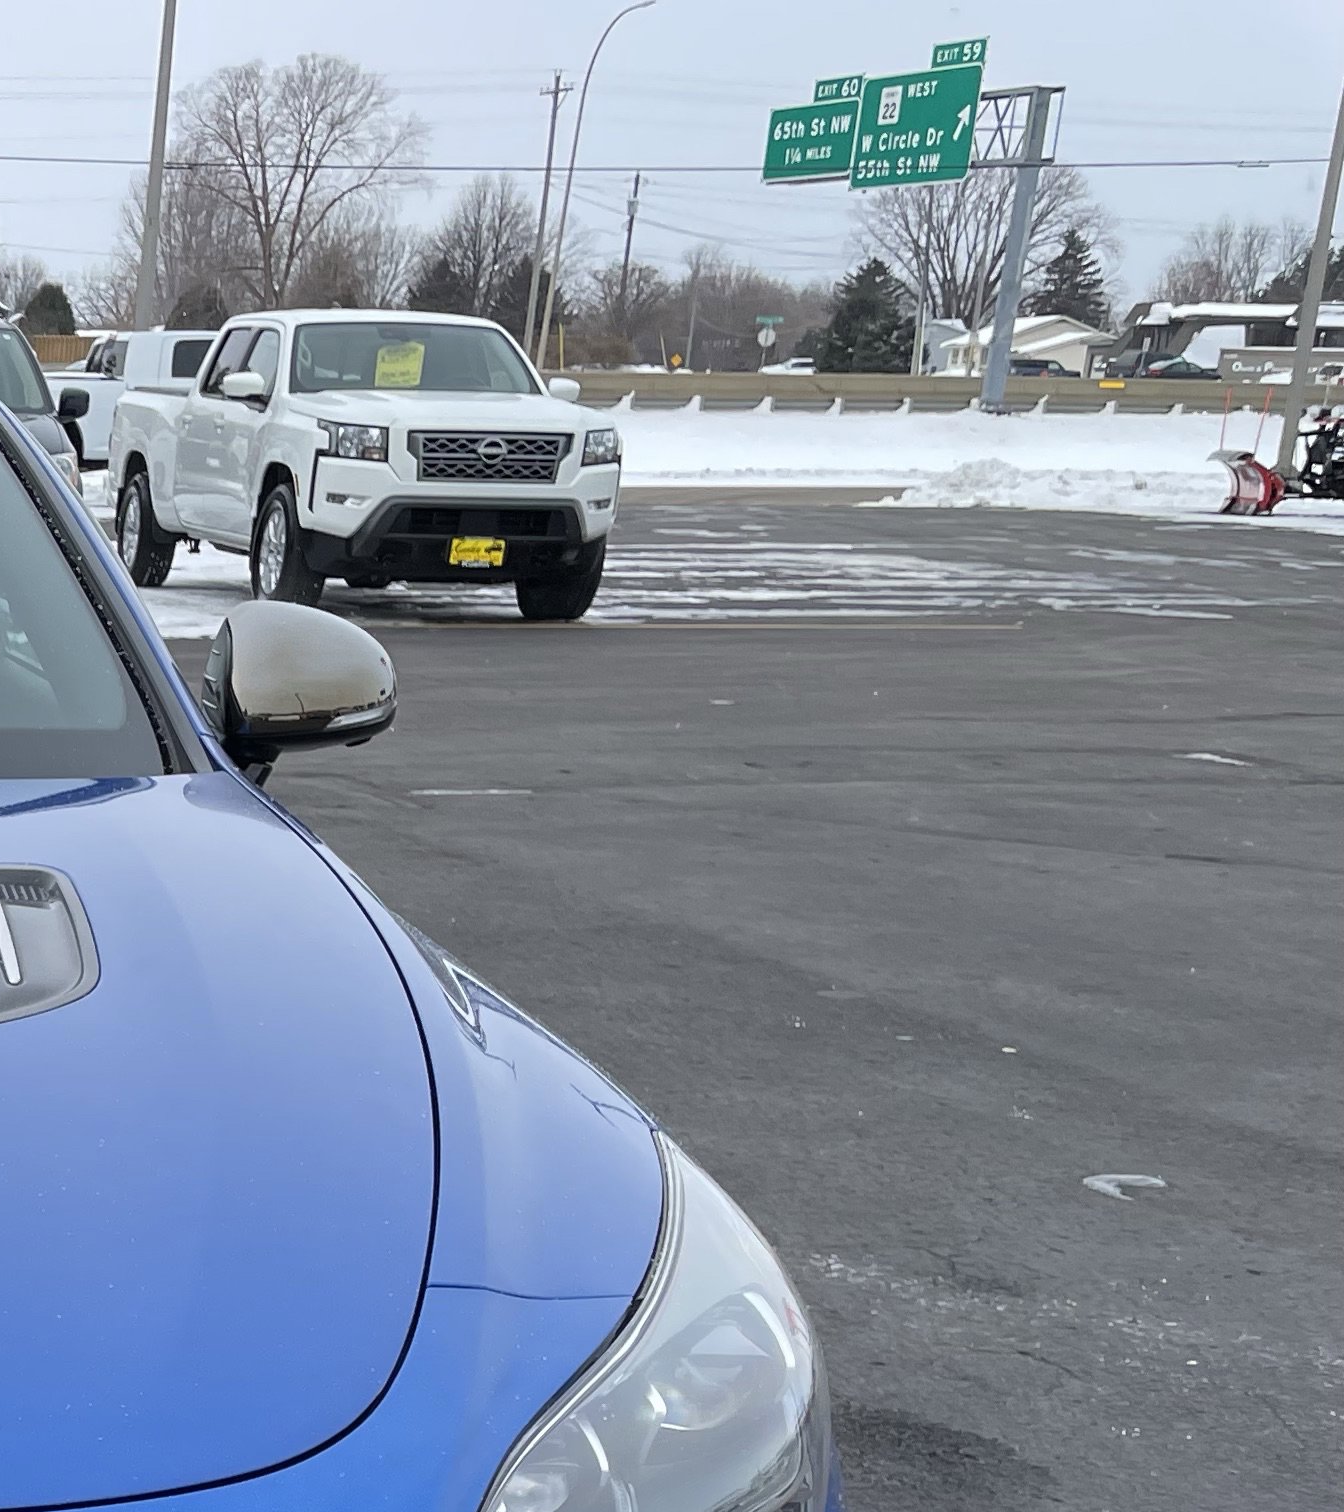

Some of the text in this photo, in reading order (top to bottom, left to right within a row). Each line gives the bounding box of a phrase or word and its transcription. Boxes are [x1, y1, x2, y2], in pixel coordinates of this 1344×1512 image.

[936, 43, 982, 63] EXIT 59
[818, 79, 859, 97] EXIT 60
[907, 80, 938, 98] WEST
[882, 102, 897, 120] 22
[773, 114, 853, 141] 65th St NW
[862, 127, 944, 153] W Circle Dr
[806, 146, 832, 161] MILES
[856, 153, 941, 179] 55th St NW
